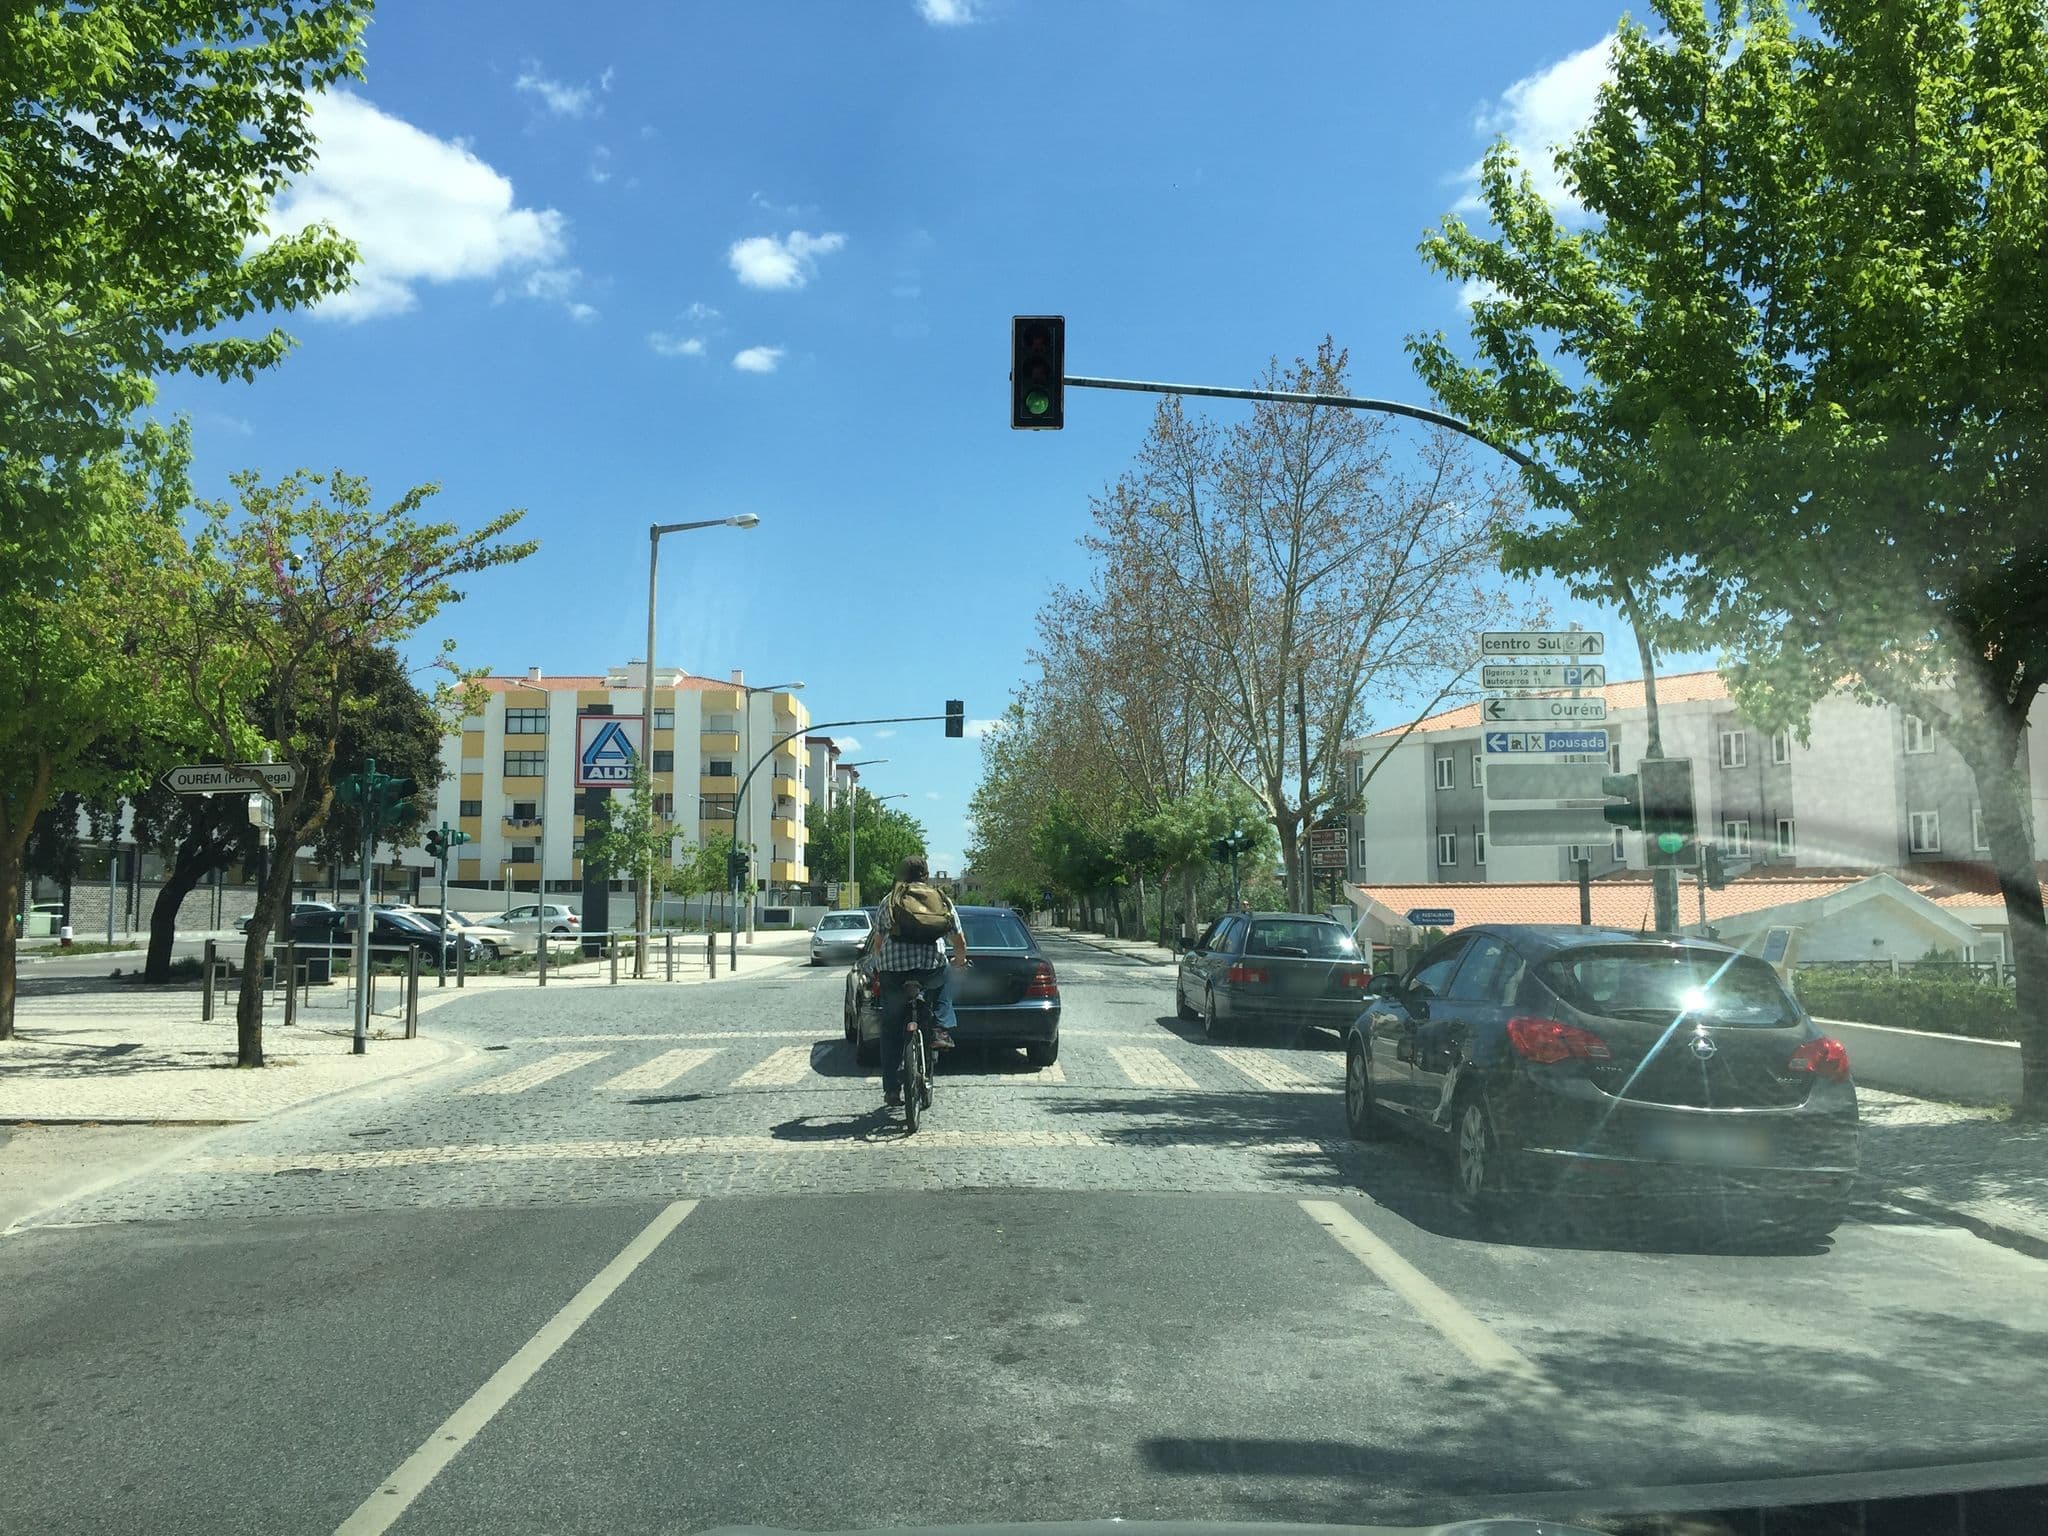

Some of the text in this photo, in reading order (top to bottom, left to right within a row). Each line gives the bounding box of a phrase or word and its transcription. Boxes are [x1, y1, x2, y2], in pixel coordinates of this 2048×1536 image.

[1485, 637, 1561, 650] centro Sul
[1486, 668, 1515, 677] ligeiros
[1520, 668, 1529, 676] 12
[1542, 668, 1551, 676] 14
[1486, 678, 1530, 686] autocarros
[1551, 702, 1603, 716] Ourém
[1548, 737, 1605, 749] pousada
[177, 772, 221, 785] OURÉM
[588, 767, 632, 779] ALDI
